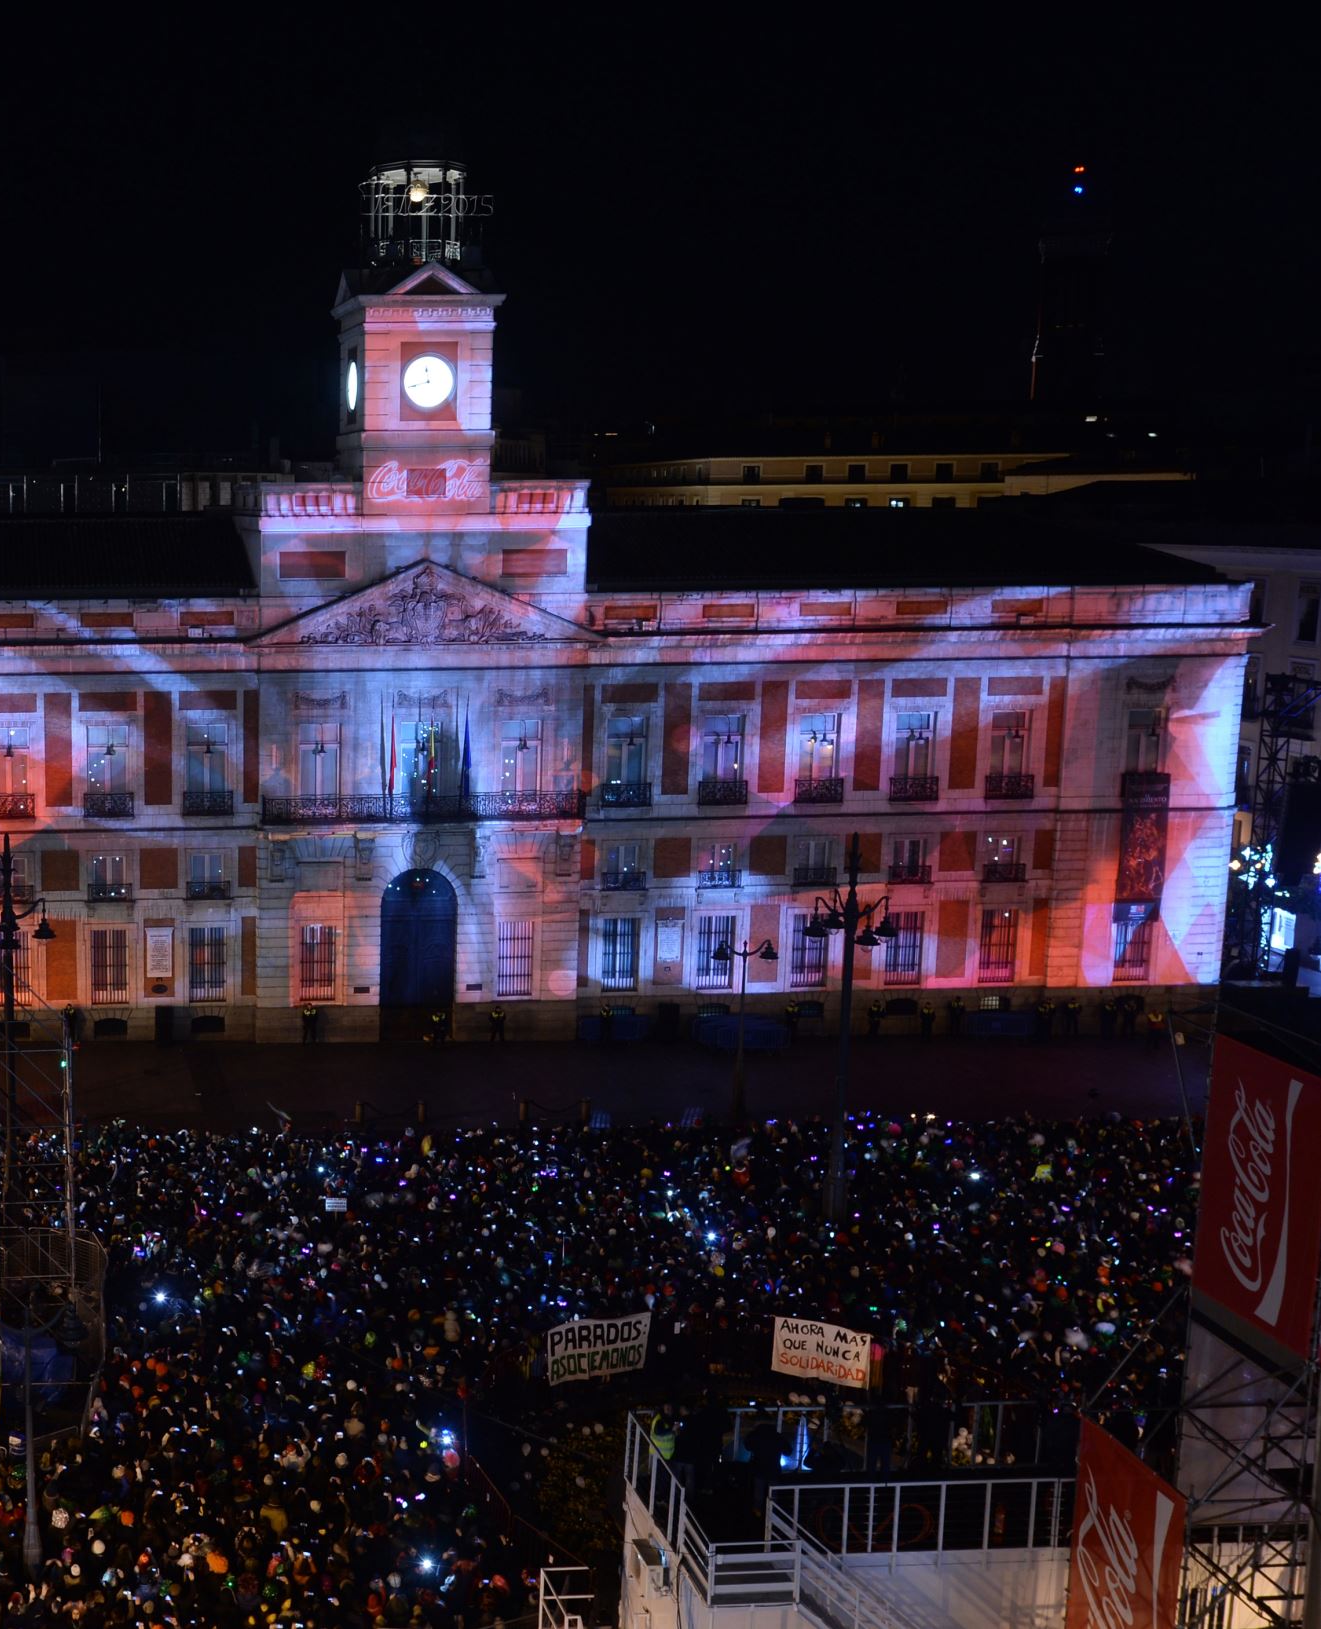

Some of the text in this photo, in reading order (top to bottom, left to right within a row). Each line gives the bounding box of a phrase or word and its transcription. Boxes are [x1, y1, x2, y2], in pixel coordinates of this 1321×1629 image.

[441, 194, 494, 216] 2015
[1220, 1077, 1275, 1292] Coca-Cola
[549, 1321, 648, 1357] PARADOS:
[780, 1319, 868, 1347] AHORA MAS
[550, 1344, 644, 1380] ASOCIEMONOS
[783, 1338, 861, 1362] QUE NUNCA
